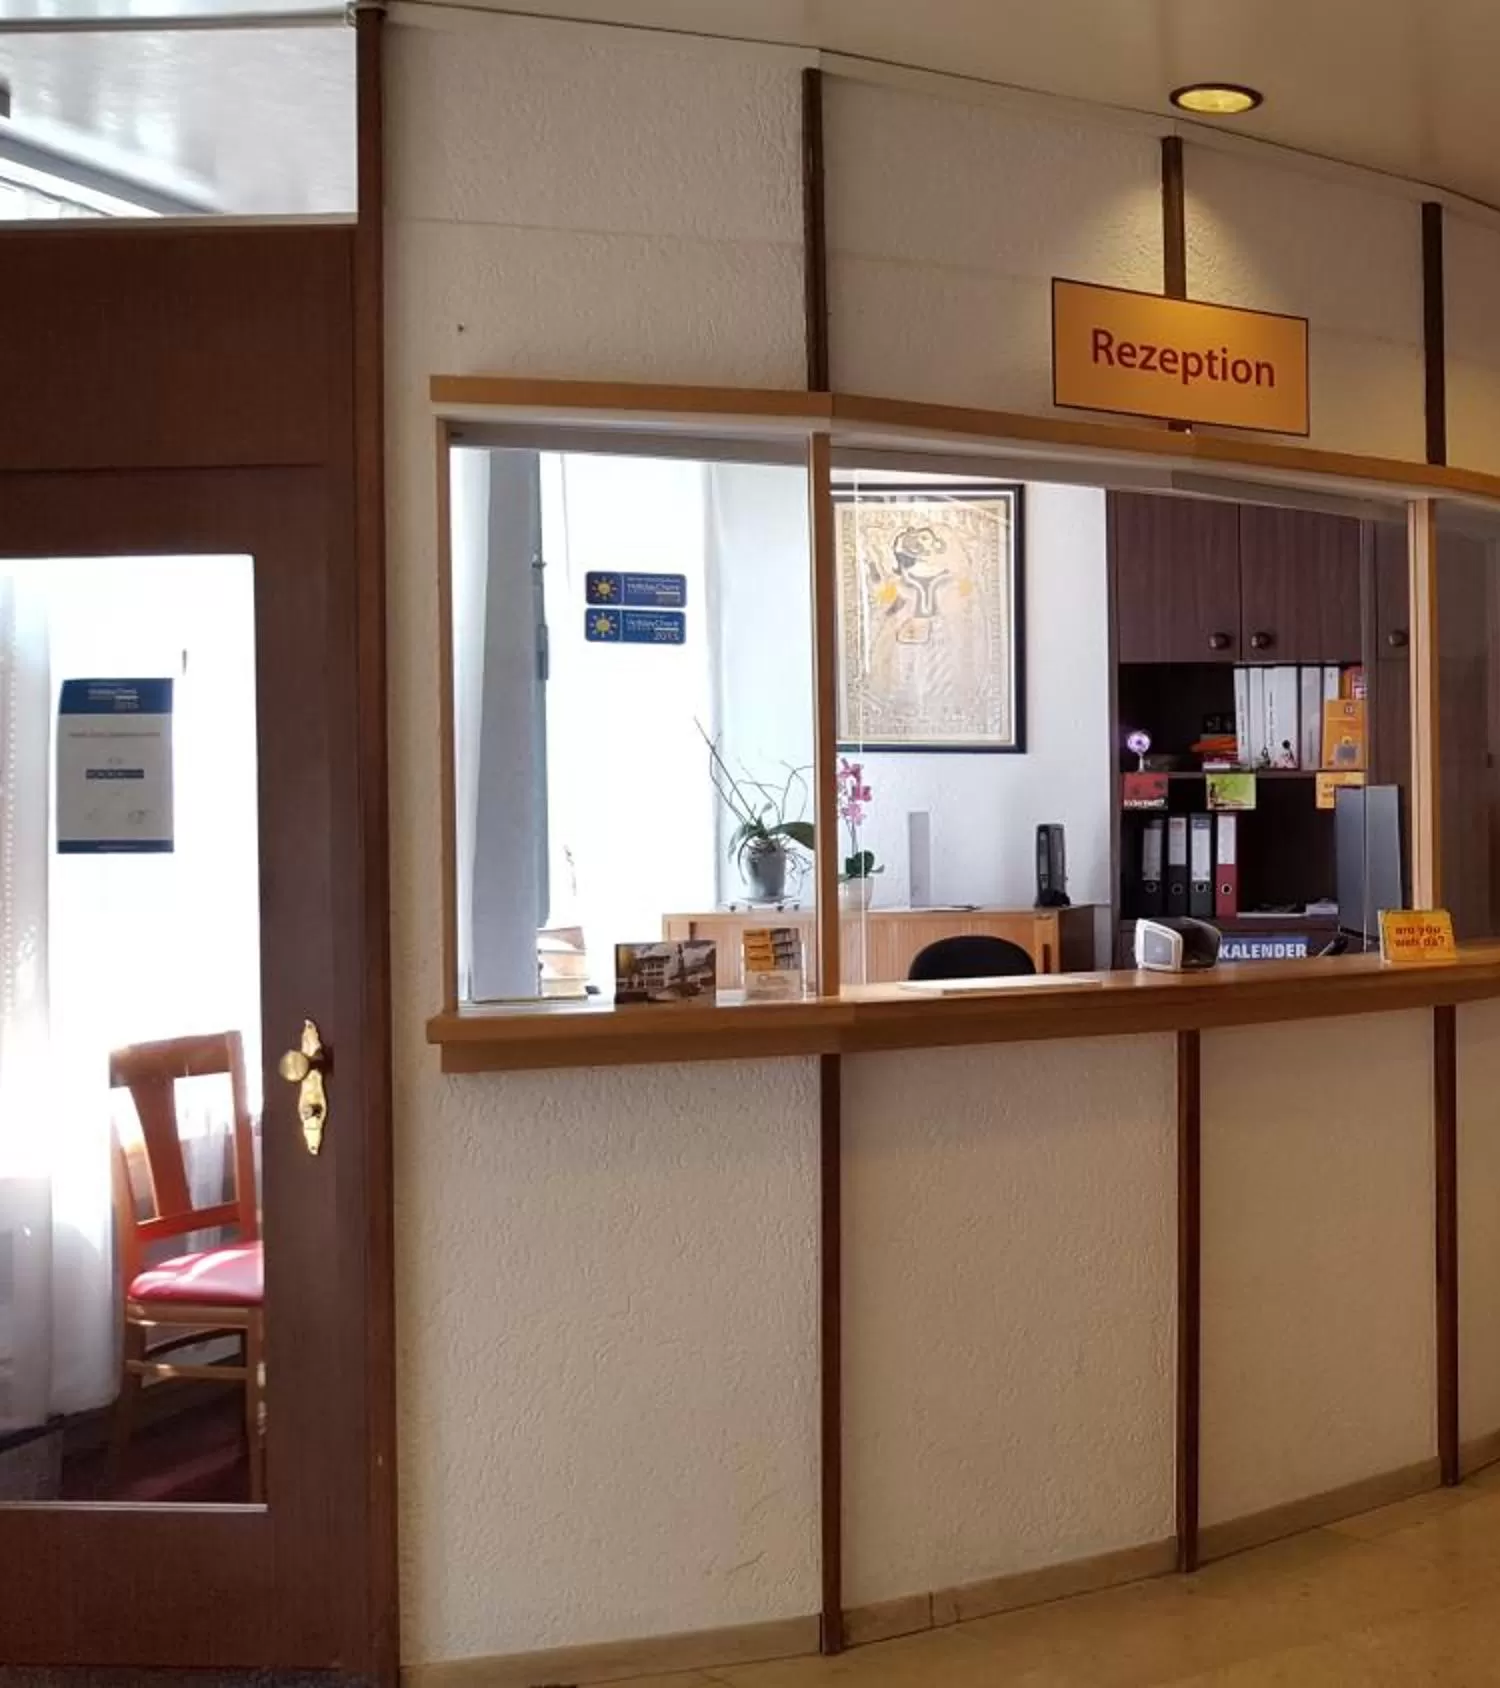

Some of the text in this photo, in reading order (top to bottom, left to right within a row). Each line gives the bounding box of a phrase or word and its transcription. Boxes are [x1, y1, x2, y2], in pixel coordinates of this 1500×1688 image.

[1091, 328, 1275, 388] Rezeption
[1417, 926, 1441, 937] you
[1218, 943, 1308, 960] KALENDER
